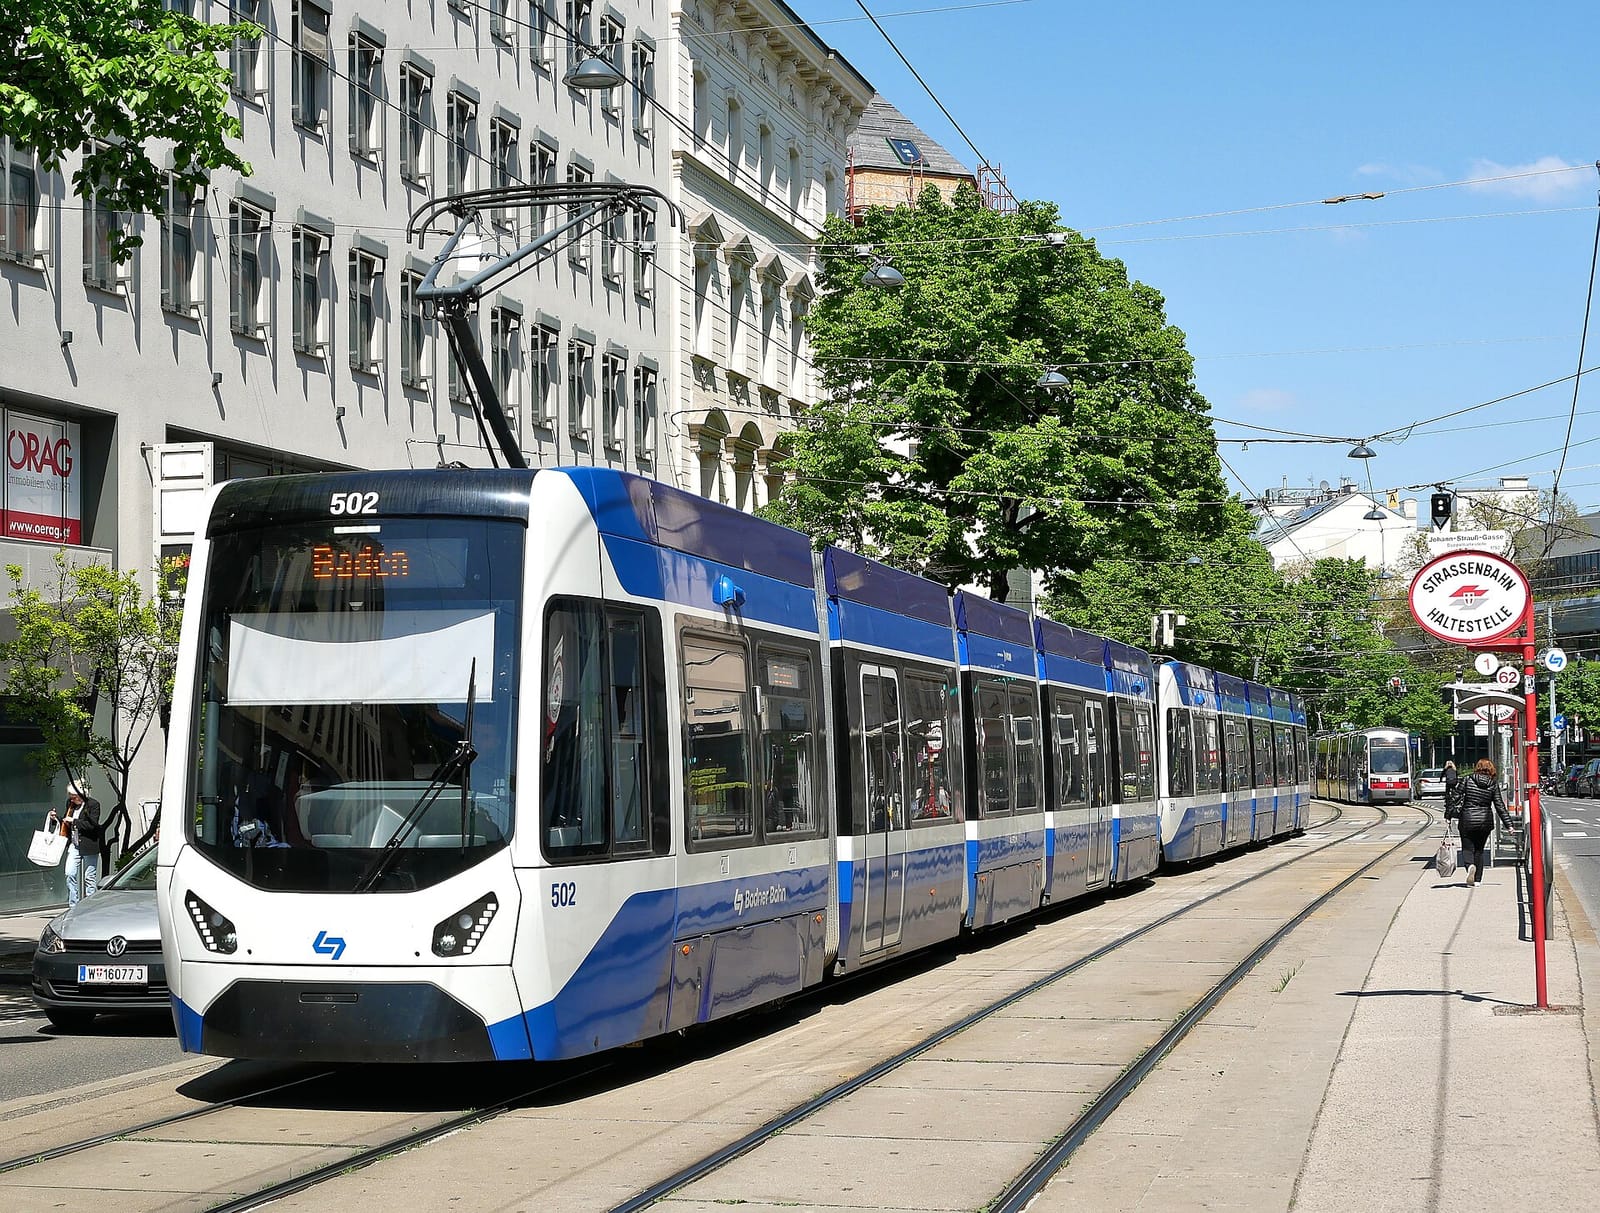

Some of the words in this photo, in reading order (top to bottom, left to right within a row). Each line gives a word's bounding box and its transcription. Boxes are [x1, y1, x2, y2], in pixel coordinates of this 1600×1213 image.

[329, 491, 379, 515] 502
[1422, 561, 1516, 593] STRASSENBAHN
[1426, 605, 1513, 633] HALTESTELLE
[1483, 658, 1490, 670] 1
[1498, 671, 1518, 684] 62
[551, 881, 576, 908] 502
[744, 887, 769, 909] Badner
[769, 883, 786, 904] Bahn
